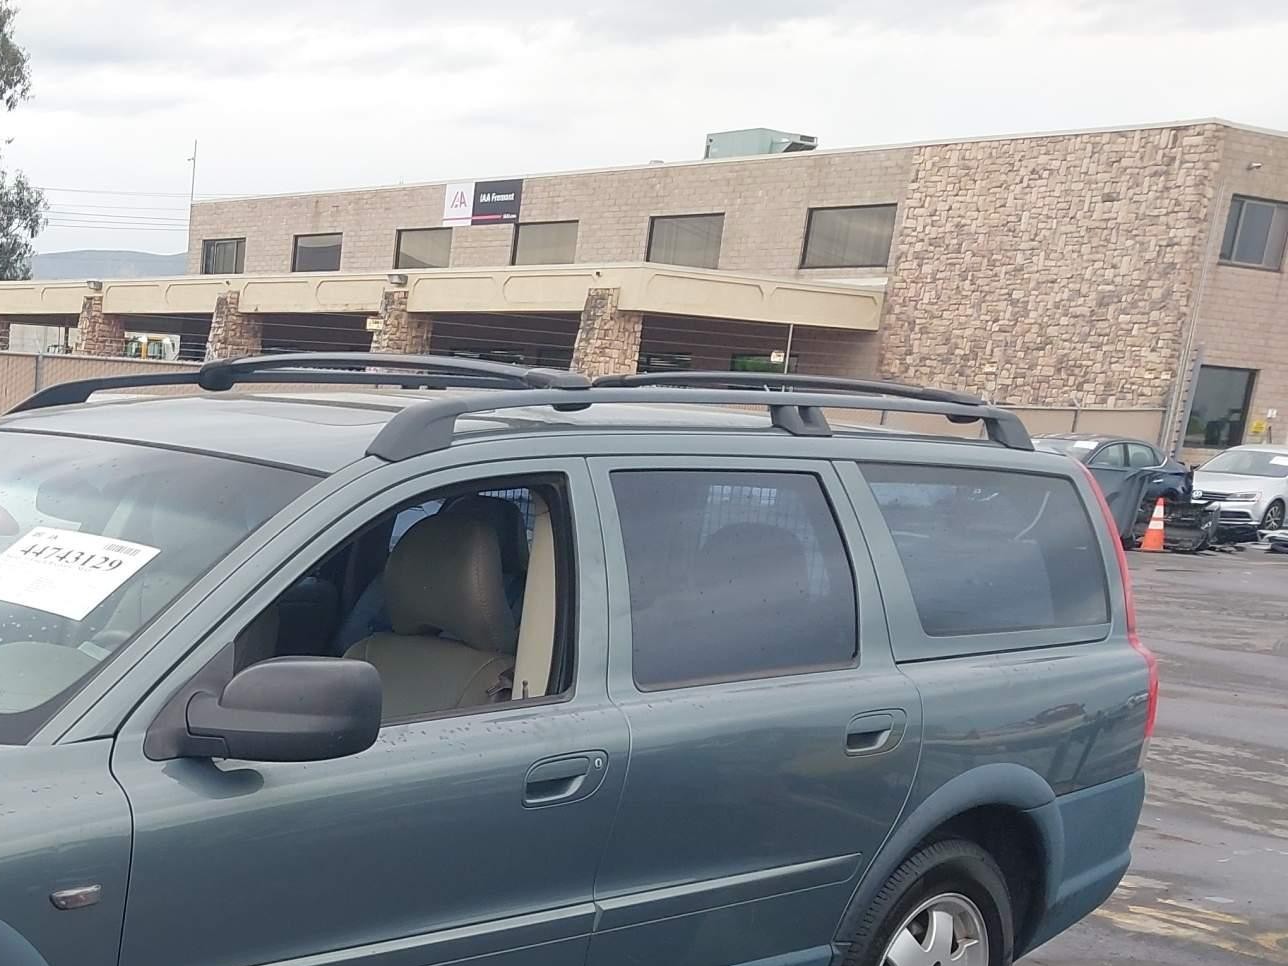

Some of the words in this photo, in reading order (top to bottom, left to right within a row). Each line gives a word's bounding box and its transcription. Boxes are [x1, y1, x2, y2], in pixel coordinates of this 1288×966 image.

[480, 193, 490, 203] IAA
[491, 192, 515, 202] Fremont
[20, 543, 123, 571] 44743129
